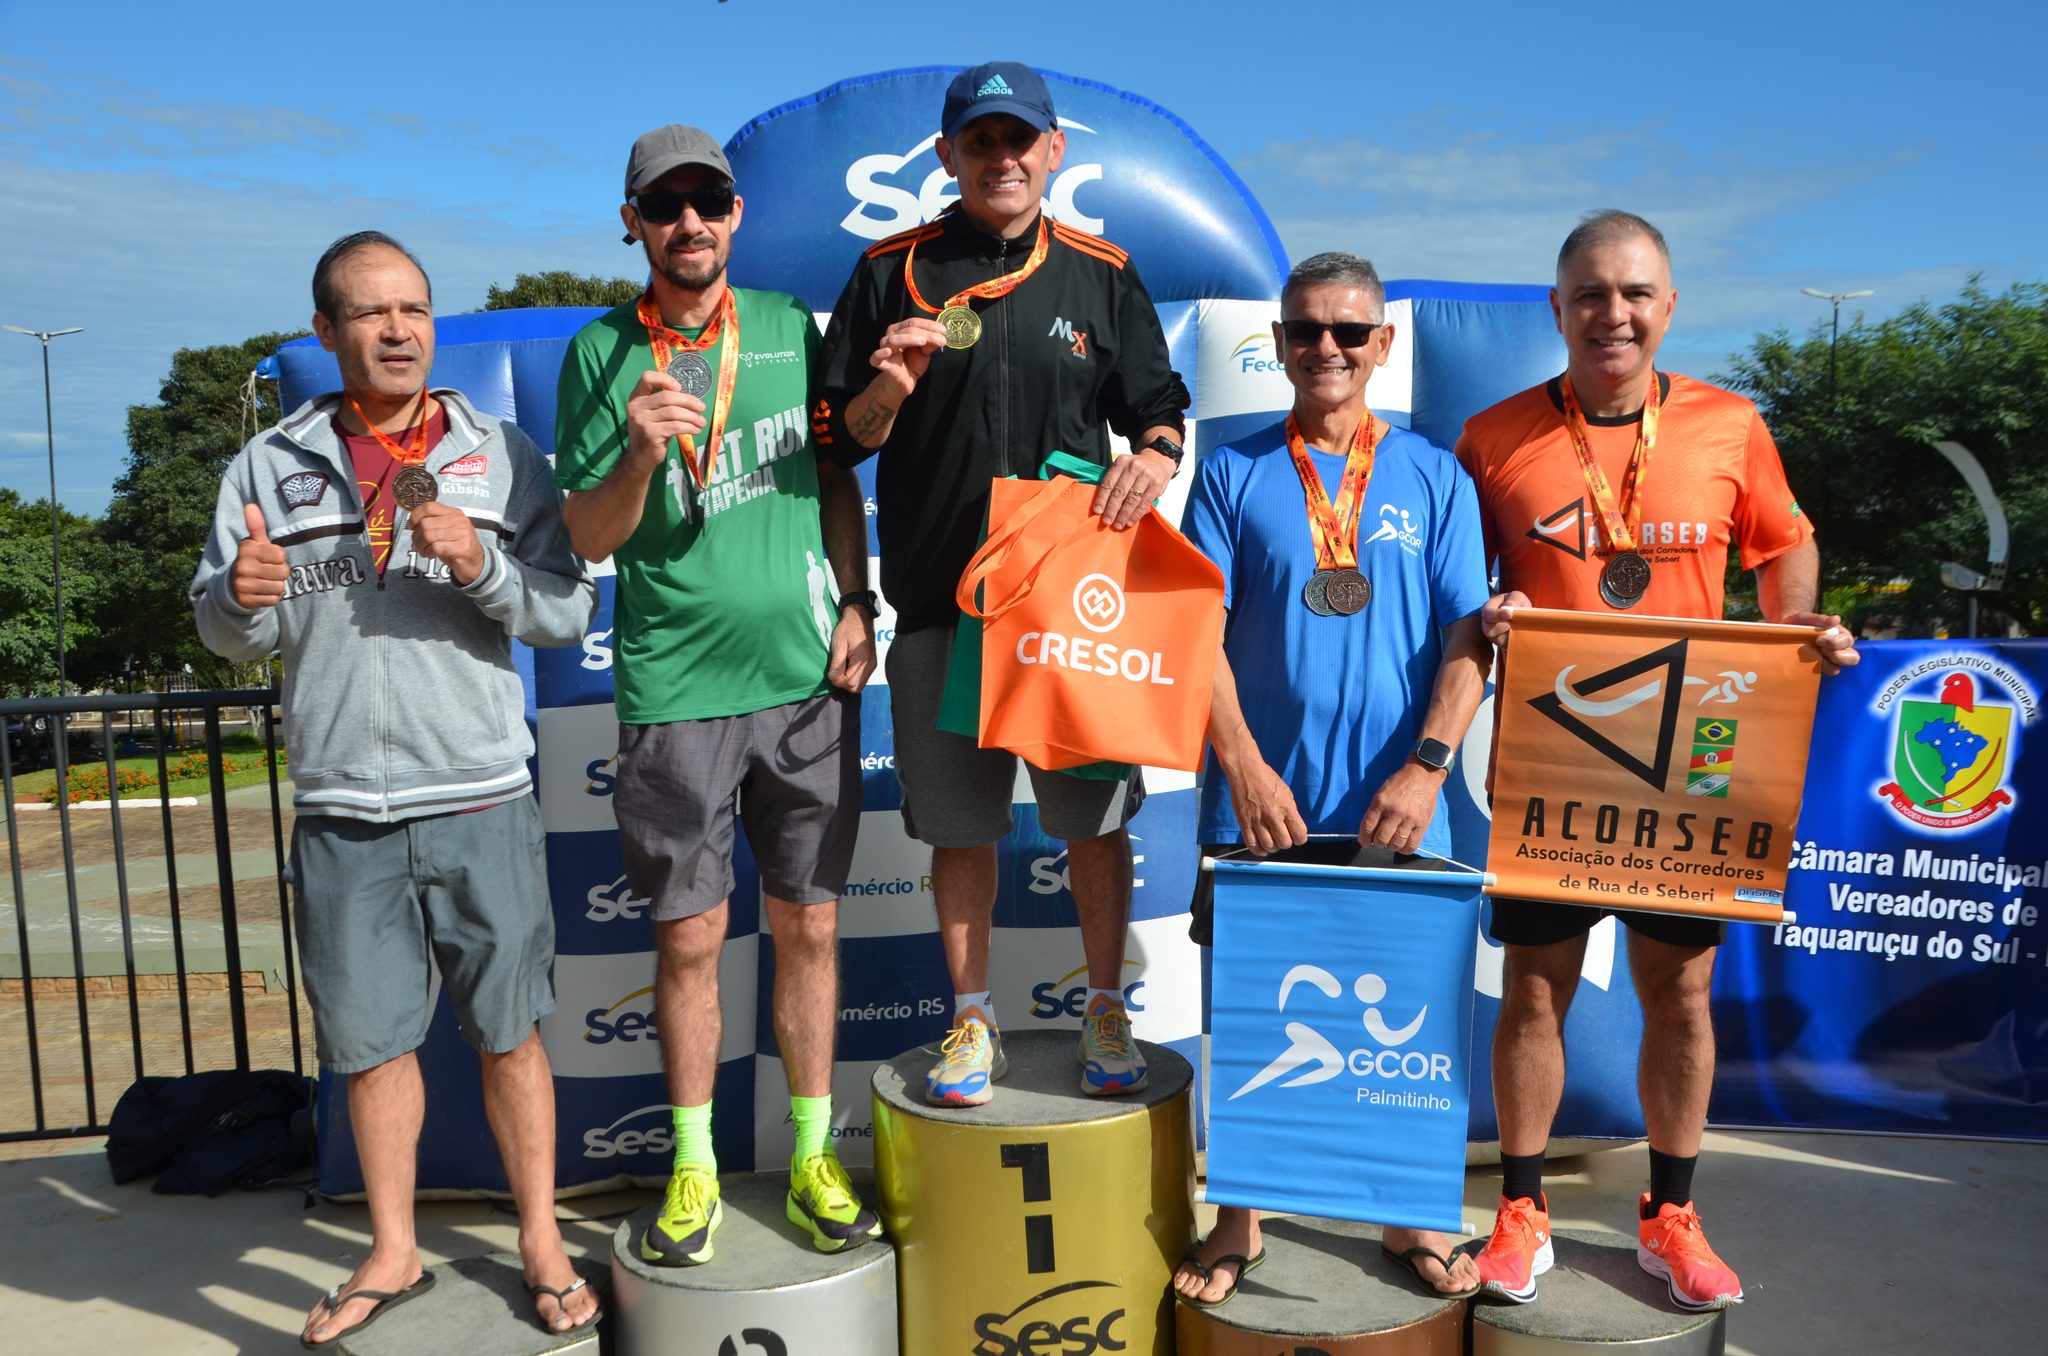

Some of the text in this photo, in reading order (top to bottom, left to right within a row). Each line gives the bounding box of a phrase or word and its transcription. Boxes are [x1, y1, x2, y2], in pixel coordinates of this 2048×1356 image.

[977, 86, 1013, 97] adidas
[840, 154, 1104, 240] Sec
[755, 350, 795, 360] EVOLUTION
[754, 404, 808, 466] RUN
[441, 481, 490, 498] Gibson
[1398, 530, 1421, 548] GCOR
[1588, 521, 1707, 548] ARSEB
[1656, 546, 1699, 554] Corredores
[1016, 632, 1175, 685] CRESOL
[1877, 657, 2037, 722] PODER LEGISLATIVO MUNICIPAL
[1522, 796, 1772, 860] ACORSEB
[1515, 842, 1765, 881] Associação dos Corredores
[1903, 848, 2048, 892] Municipal
[840, 877, 914, 897] mércio
[1559, 874, 1715, 902] de Rua de Seberi
[1829, 882, 2039, 927] Vereadores de
[1774, 923, 1918, 962] Taquaruçu
[1927, 930, 1963, 960] do
[1971, 933, 2019, 964] Sul
[918, 998, 945, 1017] RS
[1028, 980, 1145, 1019] Sec
[582, 1007, 660, 1045] Ses
[1348, 1048, 1452, 1082] GCOR
[1356, 1087, 1451, 1111] Palmitinho
[1000, 1142, 1056, 1274] 1
[972, 1308, 1127, 1356] Sesc
